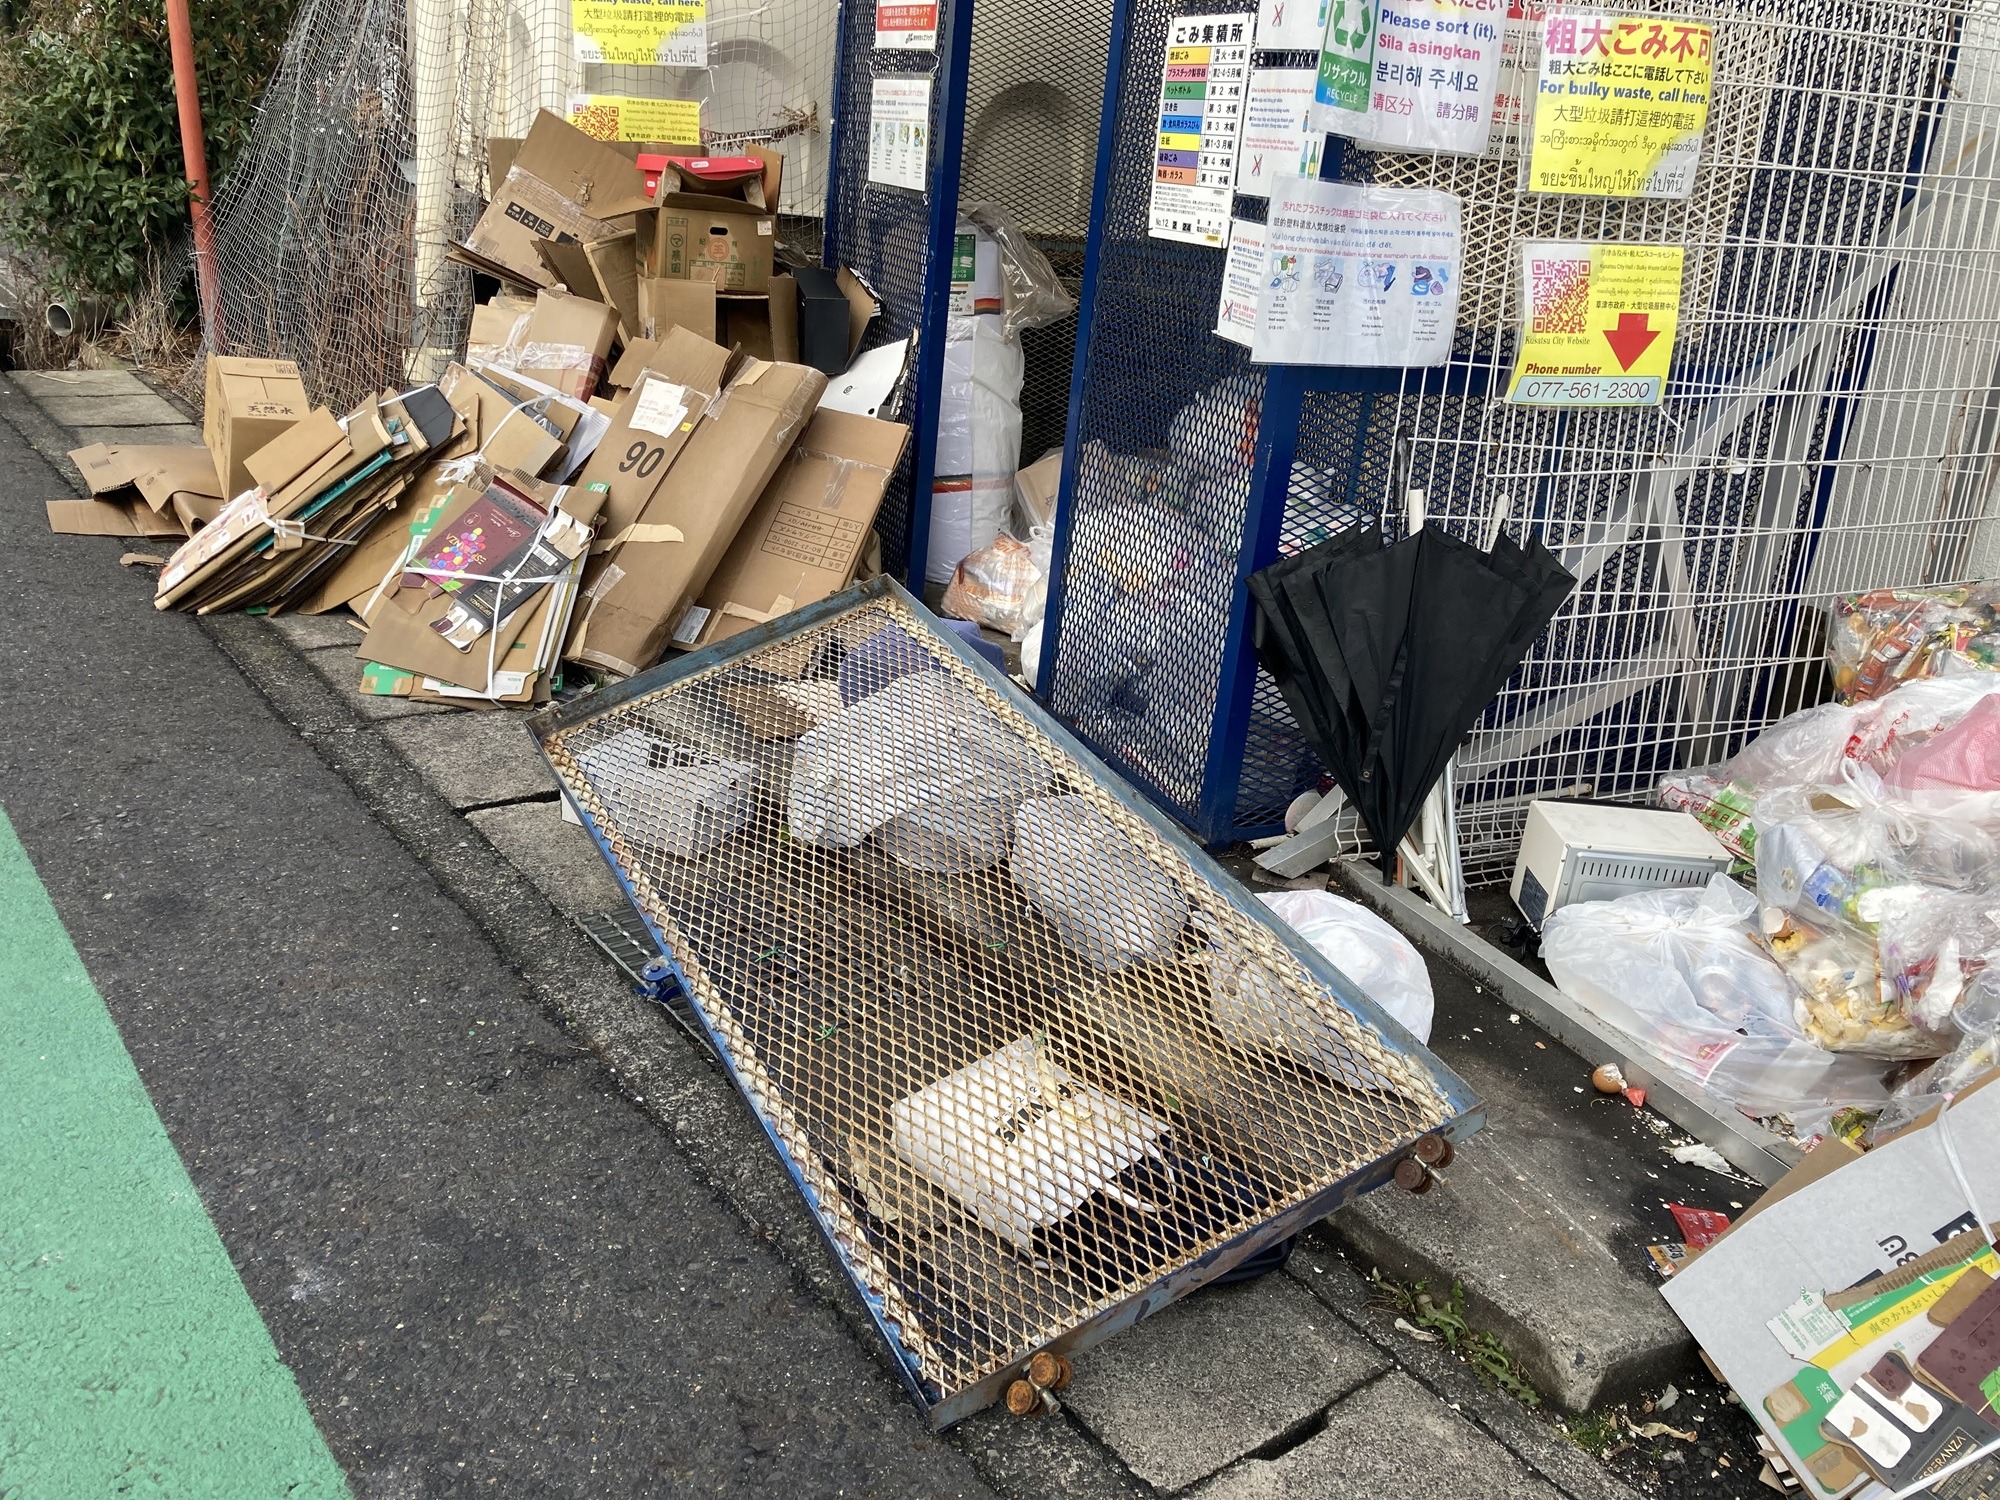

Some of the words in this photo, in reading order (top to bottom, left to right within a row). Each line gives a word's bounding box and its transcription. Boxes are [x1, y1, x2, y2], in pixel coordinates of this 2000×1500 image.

[583, 8, 695, 24] 大型垃圾請打這裡的電話
[1380, 9, 1431, 31] Please
[1435, 20, 1469, 35] sort
[1473, 23, 1497, 41] (it).
[1175, 23, 1243, 44] ごみ集積所
[1378, 33, 1404, 52] Sila
[1408, 42, 1481, 63] asingkan
[1323, 61, 1368, 88] リサイクル
[1376, 61, 1422, 87] 분리해
[1428, 68, 1479, 93] 주세요
[1548, 59, 1708, 85] 粗大ごみはここに電話して下さい
[1326, 87, 1358, 105] RECYCLE
[1373, 92, 1414, 116] 请区分
[1540, 79, 1565, 94] For
[1569, 81, 1609, 101] bulky
[1613, 87, 1655, 102] waste,
[1658, 88, 1679, 102] call
[1683, 91, 1708, 106] here.
[1437, 100, 1479, 123] 請分開
[1553, 105, 1695, 131] 大型垃圾請打這裡的電話
[1540, 159, 1686, 194] ขยะชิ้นใหญ่ให้โทรไปที่นี่
[1617, 264, 1625, 272] City
[1525, 335, 1551, 345] Kusatsu
[1552, 335, 1565, 347] City
[1567, 336, 1591, 345] Website
[1524, 363, 1560, 375] Phone
[1561, 364, 1603, 375] number
[1526, 382, 1650, 399] 077-561-2300
[247, 405, 295, 415] 天然水
[618, 441, 665, 479] 90
